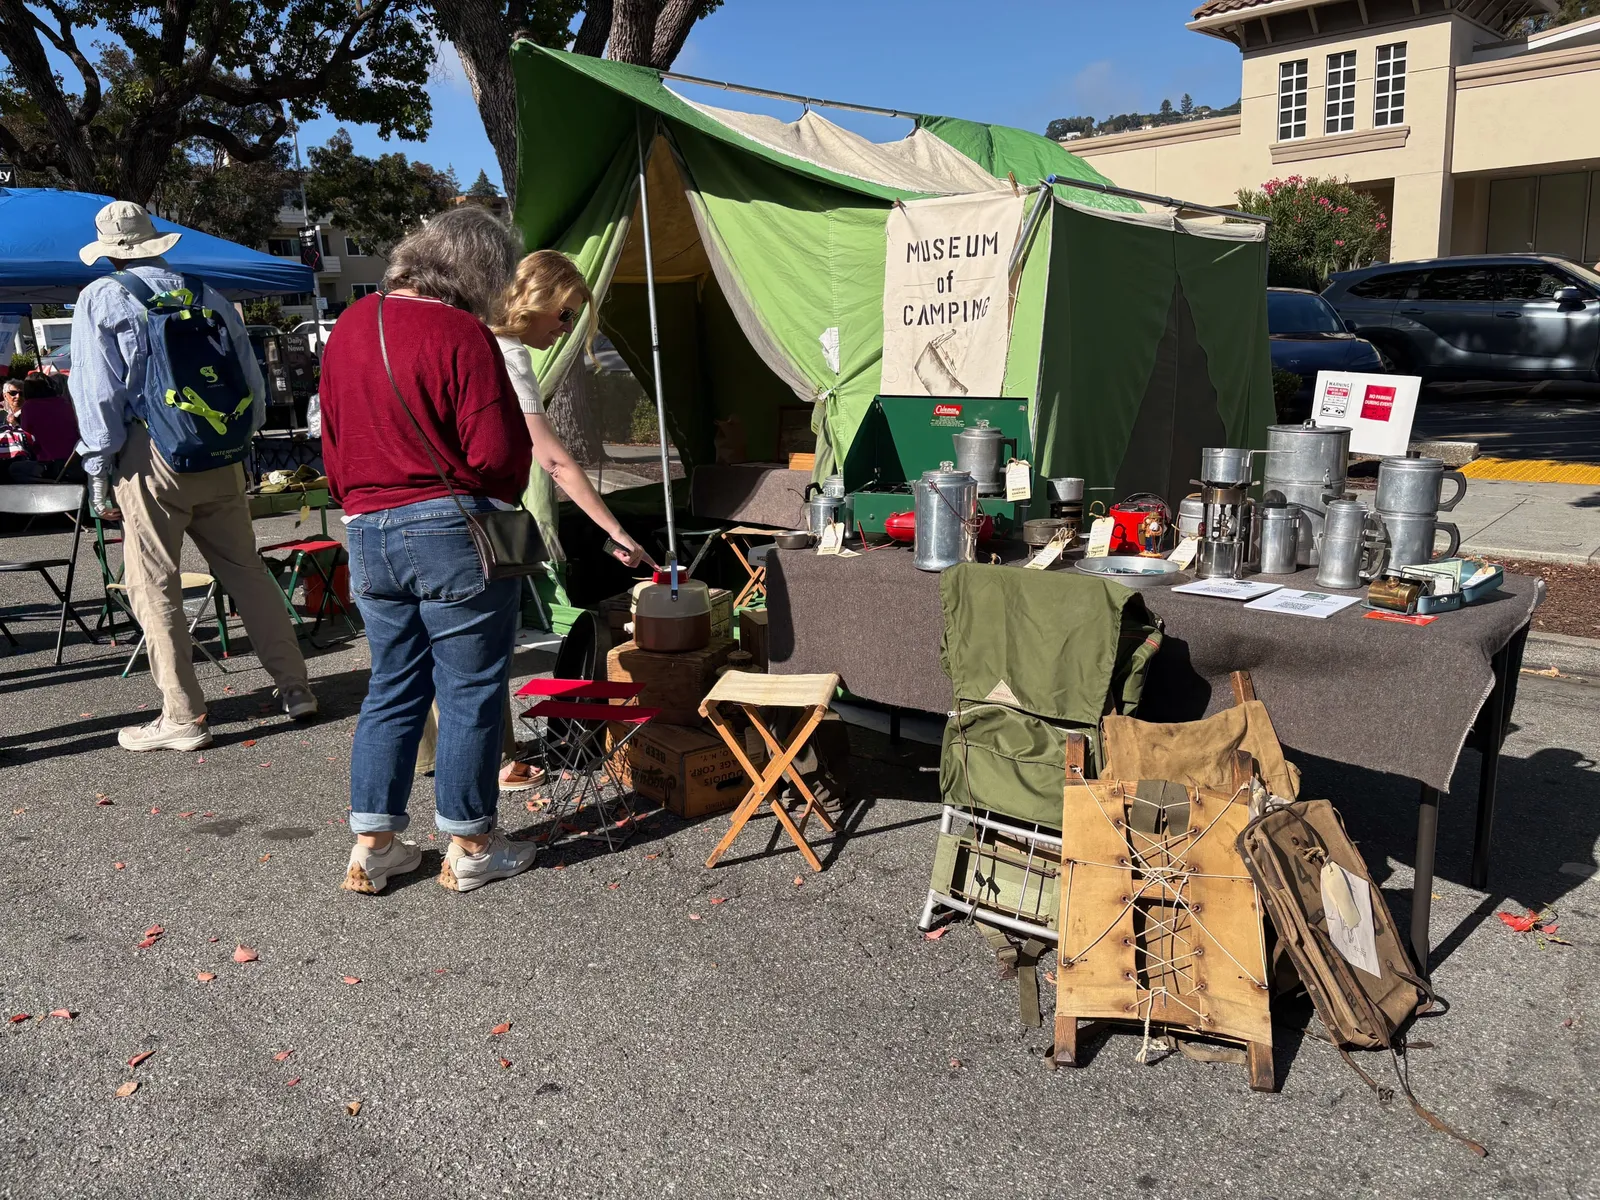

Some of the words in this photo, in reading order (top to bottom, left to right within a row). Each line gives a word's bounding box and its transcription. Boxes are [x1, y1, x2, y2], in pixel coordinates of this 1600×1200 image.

[906, 231, 999, 263] MUSEUM
[937, 270, 954, 294] of
[903, 296, 991, 326] CAMPING
[287, 337, 303, 345] Daily
[689, 765, 716, 777] CORP.
[704, 770, 744, 786] OQUOIS
